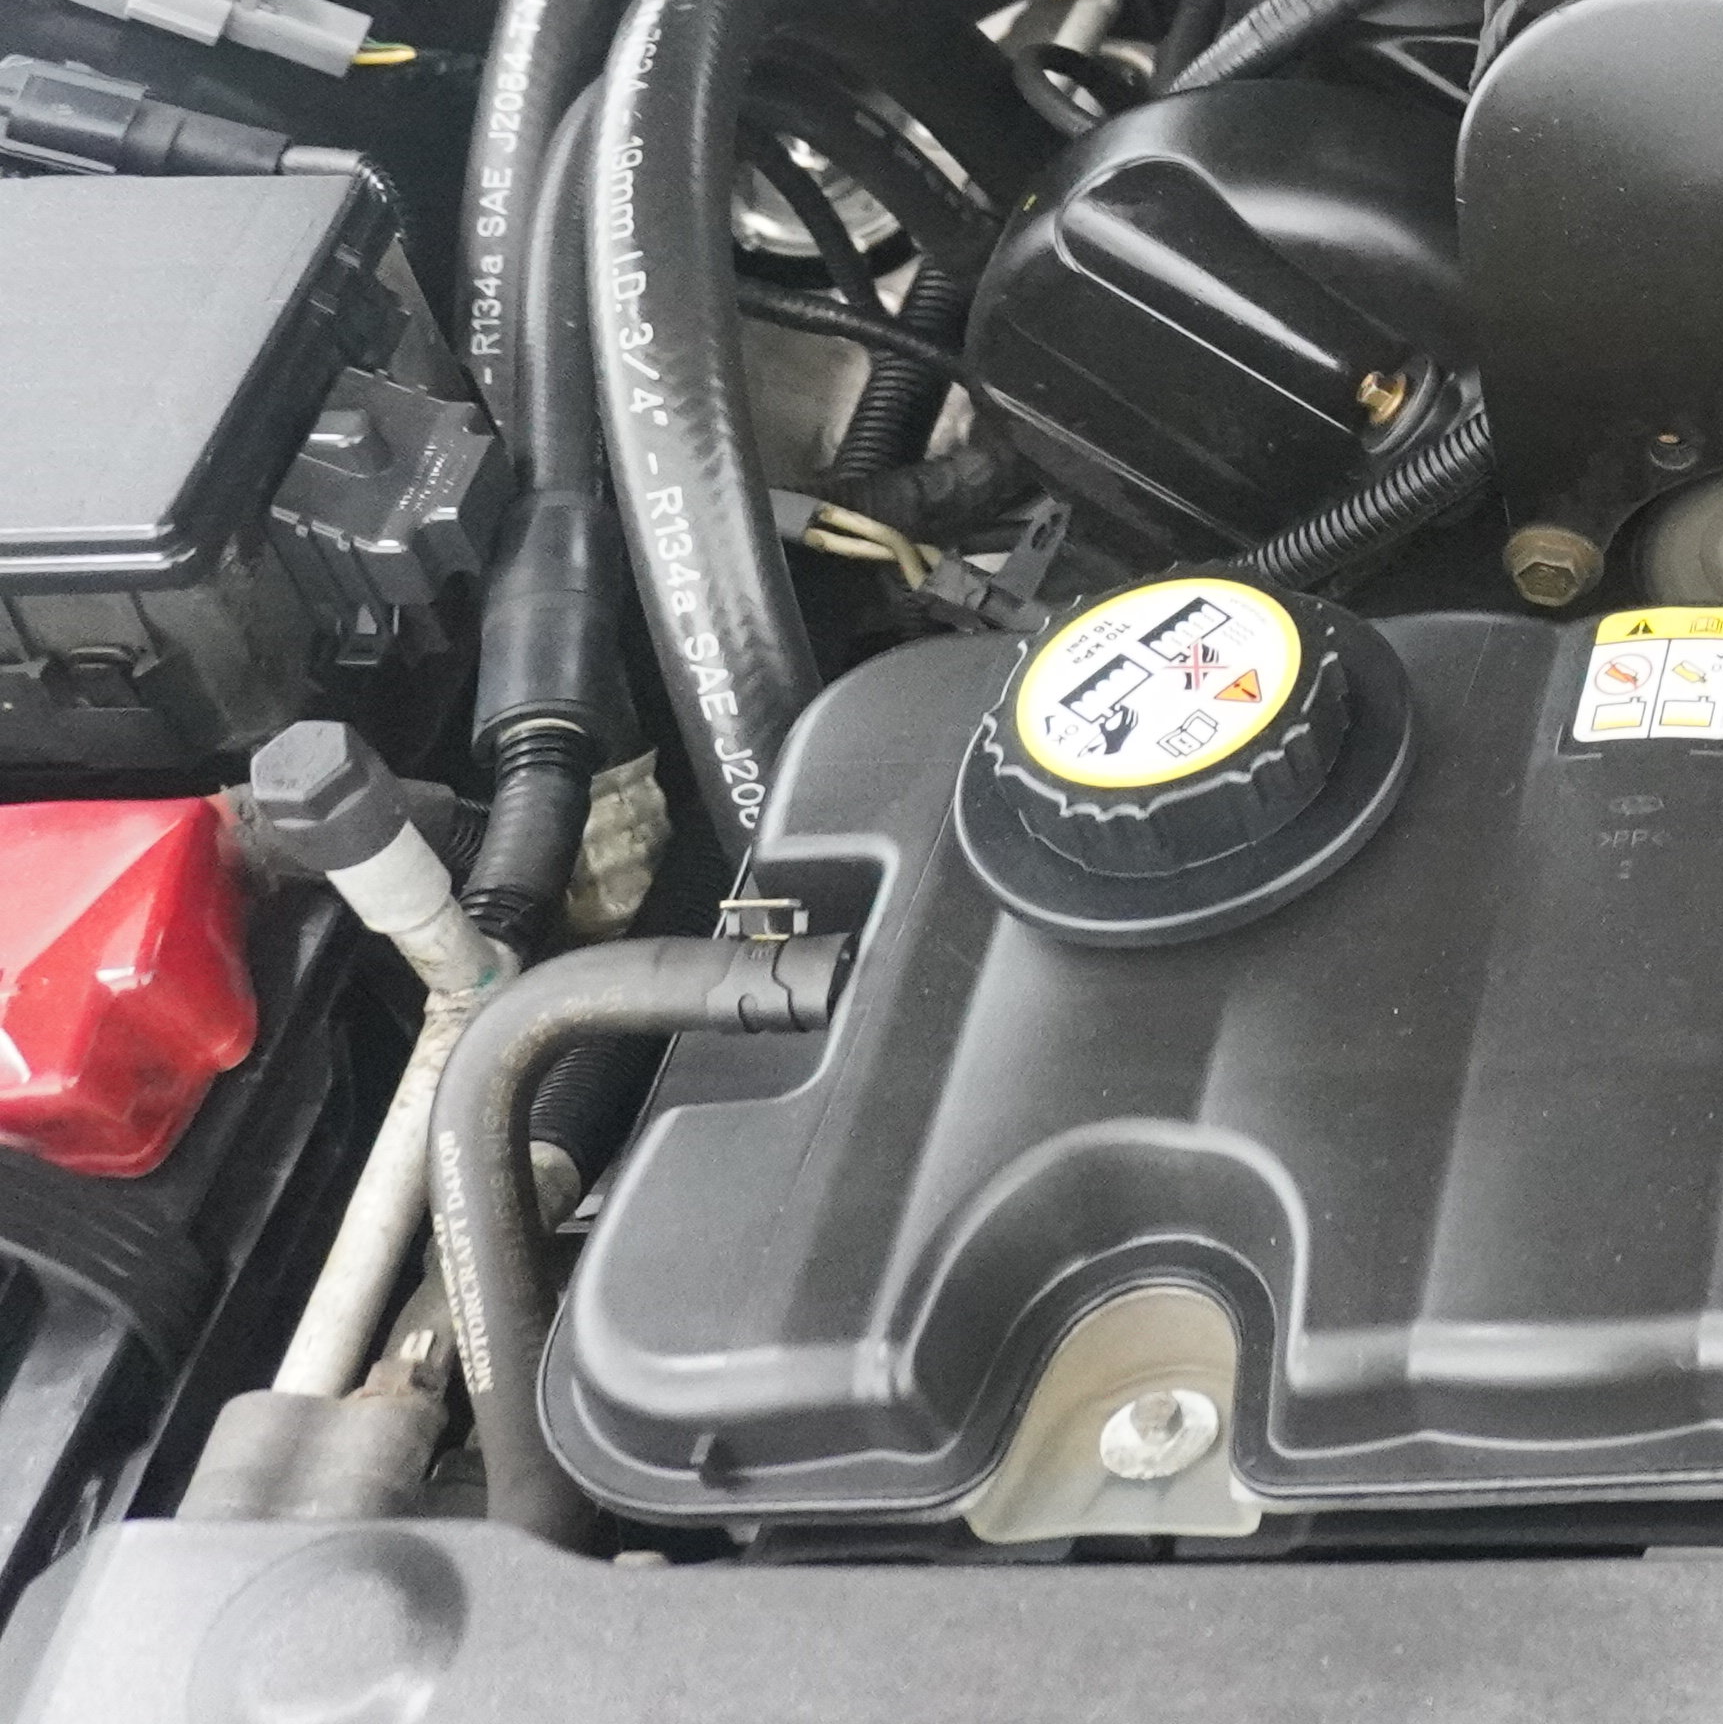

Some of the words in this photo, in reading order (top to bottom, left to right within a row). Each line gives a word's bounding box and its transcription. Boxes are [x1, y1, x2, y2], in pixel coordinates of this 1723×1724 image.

[476, 168, 512, 237] SAE
[471, 254, 505, 356] R134a
[606, 136, 644, 239] 19mm
[645, 484, 701, 618] R134a
[682, 631, 740, 723] SAE
